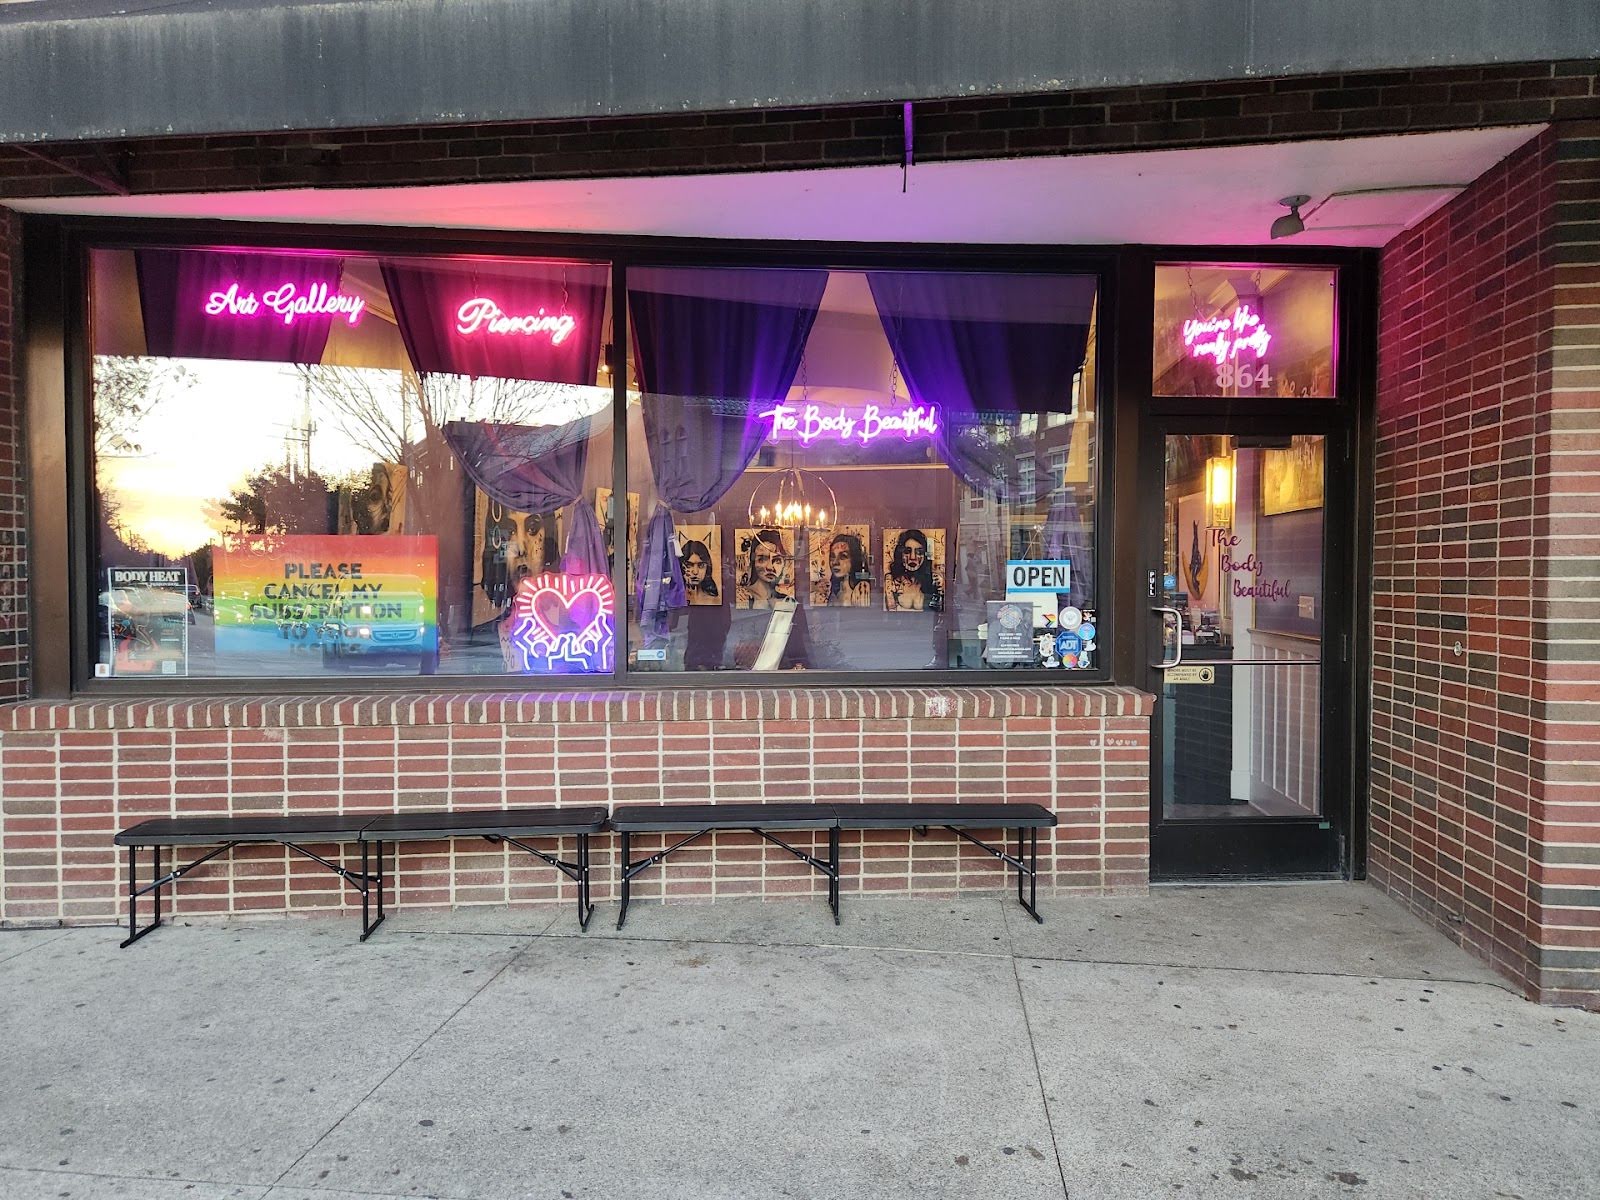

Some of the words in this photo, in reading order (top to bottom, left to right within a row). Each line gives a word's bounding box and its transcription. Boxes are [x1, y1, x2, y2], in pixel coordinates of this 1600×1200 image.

[205, 283, 257, 315] Art
[262, 283, 365, 324] Gallery
[457, 298, 576, 345] Piercing
[1216, 364, 1273, 389] 864
[759, 405, 798, 439] The
[798, 404, 856, 443] Body
[857, 404, 938, 443] Beautiful
[1206, 527, 1242, 547] The
[284, 562, 362, 580] PLEASE
[1221, 554, 1263, 576] Body
[114, 571, 149, 582] BODY
[149, 571, 181, 582] HEAT
[1013, 566, 1065, 587] OPEN
[264, 583, 347, 600] CANCEL
[352, 583, 383, 599] MY
[1233, 579, 1291, 602] Beautiful
[250, 602, 402, 620] SUBSCRIPTON
[1060, 640, 1077, 650] ADT
